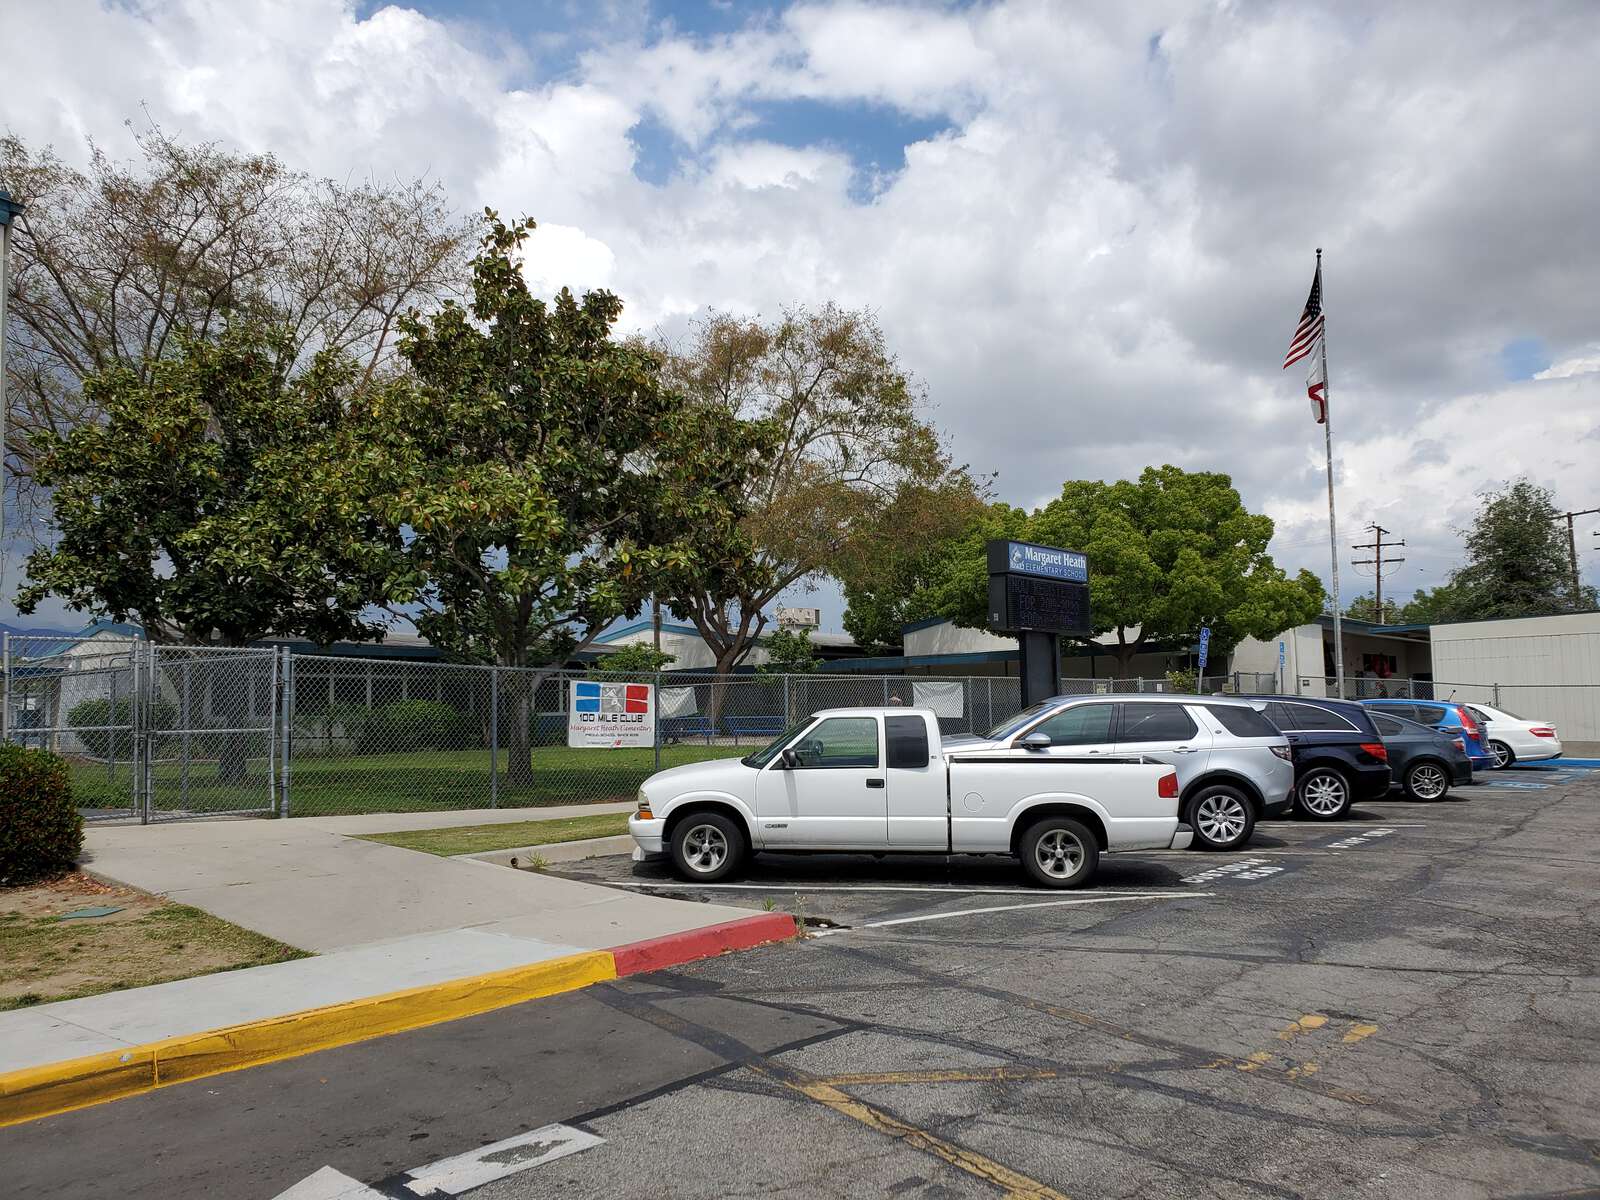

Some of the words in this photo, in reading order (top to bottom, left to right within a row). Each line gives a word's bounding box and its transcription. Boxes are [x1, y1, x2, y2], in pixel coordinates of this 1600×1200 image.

[1024, 546, 1061, 566] Margaret
[1063, 553, 1086, 569] Heath
[1025, 562, 1063, 576] ELEMENTARY
[1064, 568, 1086, 578] SCHOOL
[579, 713, 595, 722] 100
[598, 713, 618, 722] MILE
[620, 714, 643, 723] CLUB
[570, 724, 600, 733] Margaret
[600, 724, 618, 733] Heath
[620, 724, 652, 733] Elementary
